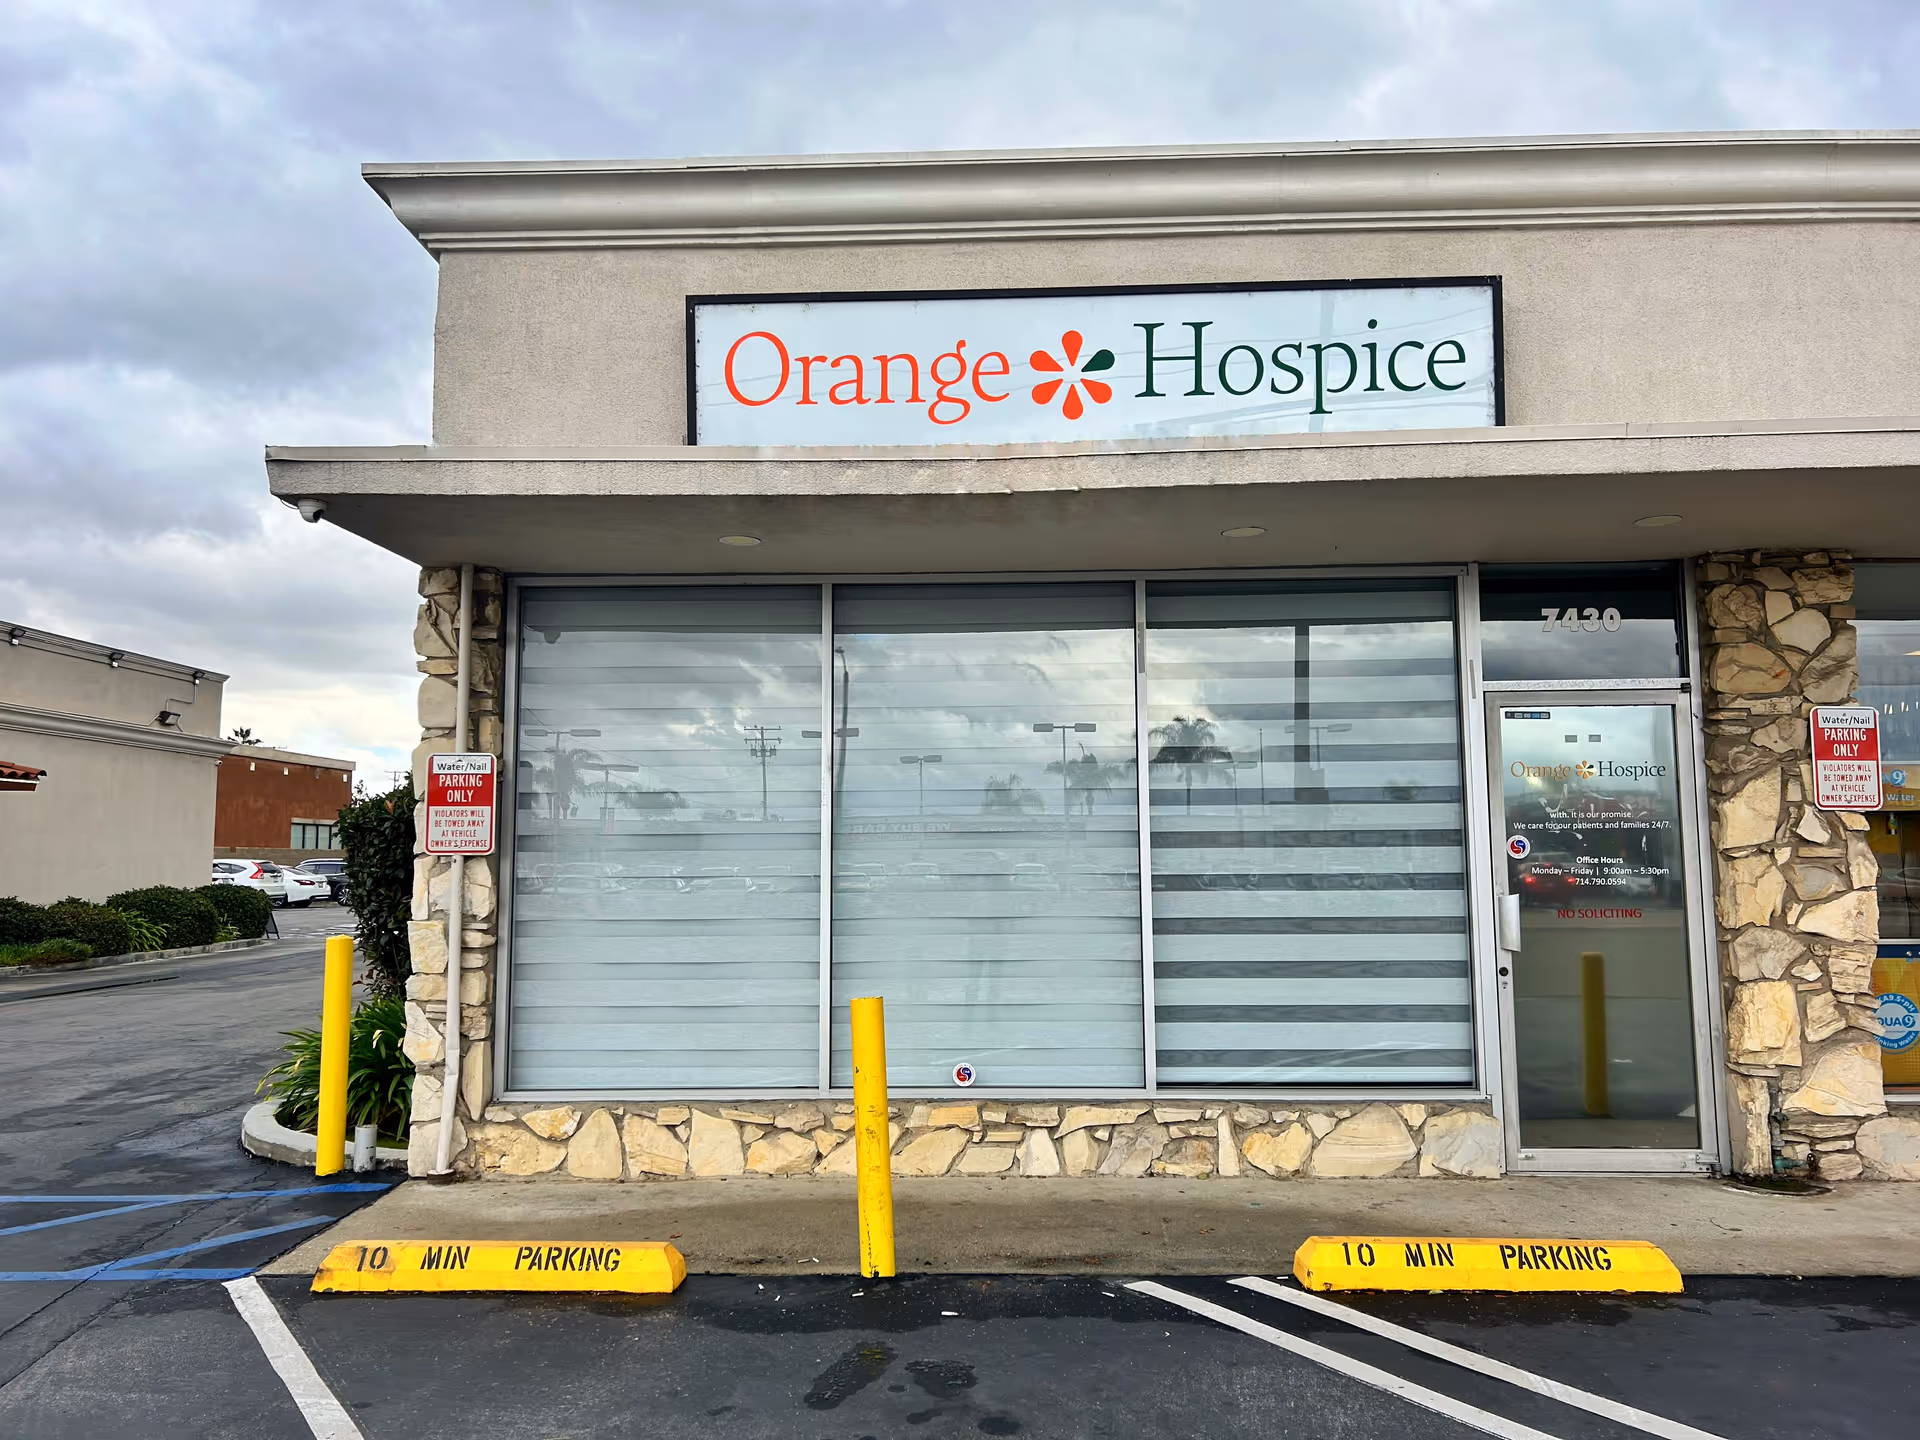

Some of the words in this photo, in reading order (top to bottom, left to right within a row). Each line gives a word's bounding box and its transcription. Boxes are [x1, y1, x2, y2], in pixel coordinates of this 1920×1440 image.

[723, 331, 1010, 425] Orange
[1132, 319, 1467, 414] Hospice
[1541, 607, 1622, 632] 7430
[1822, 716, 1870, 725] Water/Nail
[1824, 728, 1867, 741] PARKING
[1833, 744, 1859, 757] ONLY
[437, 762, 487, 772] Water/Nail
[1511, 761, 1573, 781] Orange
[1597, 760, 1666, 781] Hospice
[1823, 764, 1855, 772] VIOLATORS
[1857, 764, 1871, 772] WILL
[439, 774, 483, 787] PARKING
[1824, 774, 1831, 782] BE
[1834, 774, 1853, 782] TOWED
[1855, 774, 1872, 782] AWAY
[1831, 784, 1838, 792] AT
[1840, 784, 1865, 792] VEHICLE
[447, 789, 474, 803] ONLY
[1850, 794, 1876, 802] EXPENSE
[1886, 793, 1915, 801] Water
[435, 810, 468, 818] VIOLATORS
[470, 810, 485, 818] WILL
[1550, 811, 1570, 819] with.
[1601, 811, 1634, 820] promise.
[435, 820, 442, 828] BE
[445, 820, 465, 828] TOWED
[467, 820, 485, 828] AWAY
[1572, 821, 1603, 830] patients
[1604, 821, 1619, 829] and
[1620, 821, 1650, 829] families
[1651, 821, 1672, 829] 24/7.
[441, 830, 449, 838] AT
[1576, 856, 1599, 864] Office
[1600, 856, 1624, 864] Hours
[1531, 867, 1562, 876] Monday
[1571, 867, 1594, 876] Friday
[1603, 867, 1632, 875] 9:00am
[1640, 867, 1670, 876] 5:30pm
[1575, 878, 1626, 886] 714.790.0594
[1557, 909, 1575, 918] NO
[1578, 908, 1643, 919] SOLICITING
[357, 1246, 388, 1272] 10
[420, 1246, 471, 1270] MIN
[514, 1246, 621, 1272] PARKING
[1341, 1242, 1375, 1267] 10
[1405, 1243, 1454, 1267] MIN
[1499, 1244, 1613, 1271] PARKING
